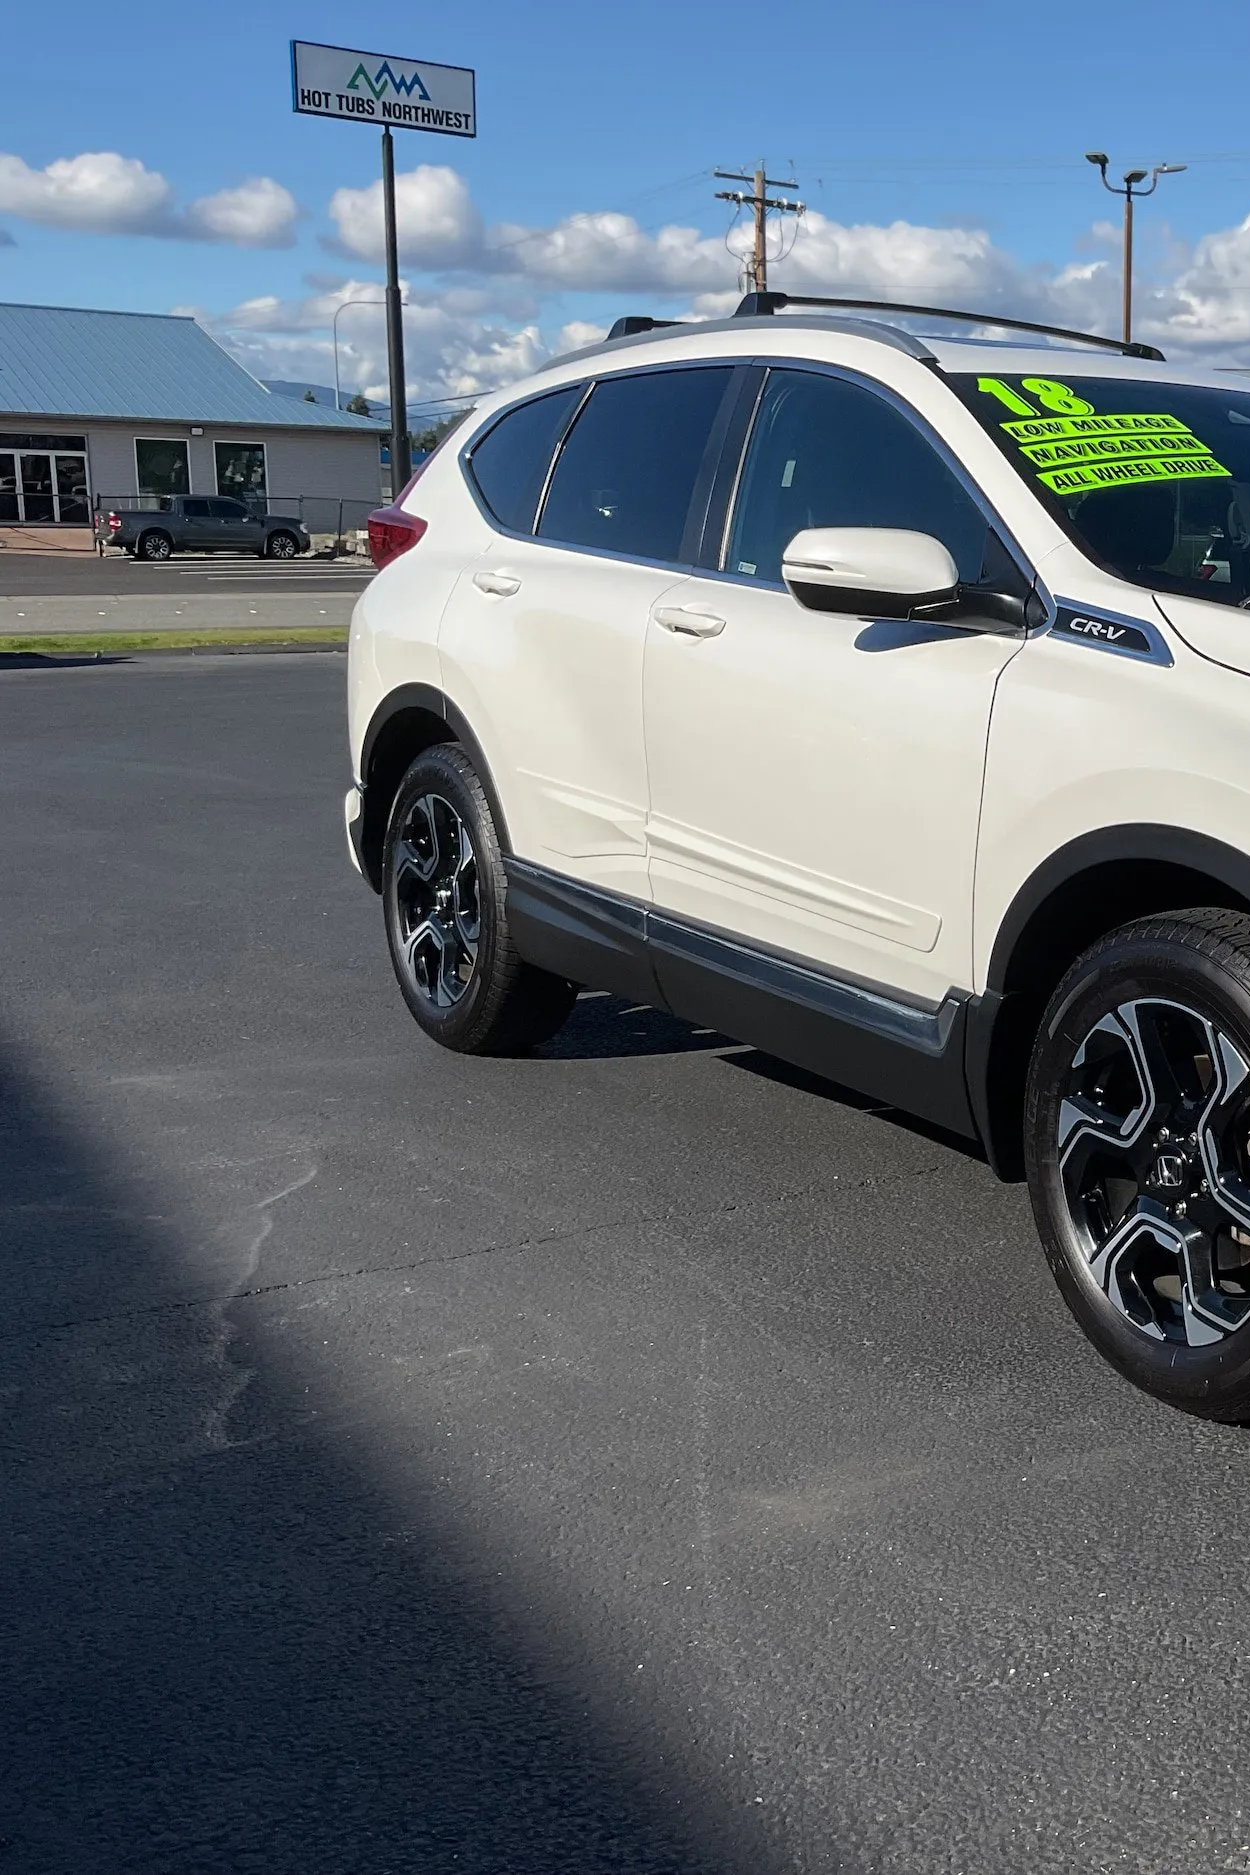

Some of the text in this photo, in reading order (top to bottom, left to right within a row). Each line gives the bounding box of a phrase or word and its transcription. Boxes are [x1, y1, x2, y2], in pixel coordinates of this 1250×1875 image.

[300, 88, 472, 130] HOT TUBS NORTHWEST
[977, 377, 1096, 417] 18
[1009, 417, 1177, 439] LOW MILEAGE
[1031, 436, 1201, 462] NAVIGATION
[1052, 459, 1219, 490] ALL WHEEL DRIVE
[1069, 617, 1126, 640] CR-V
